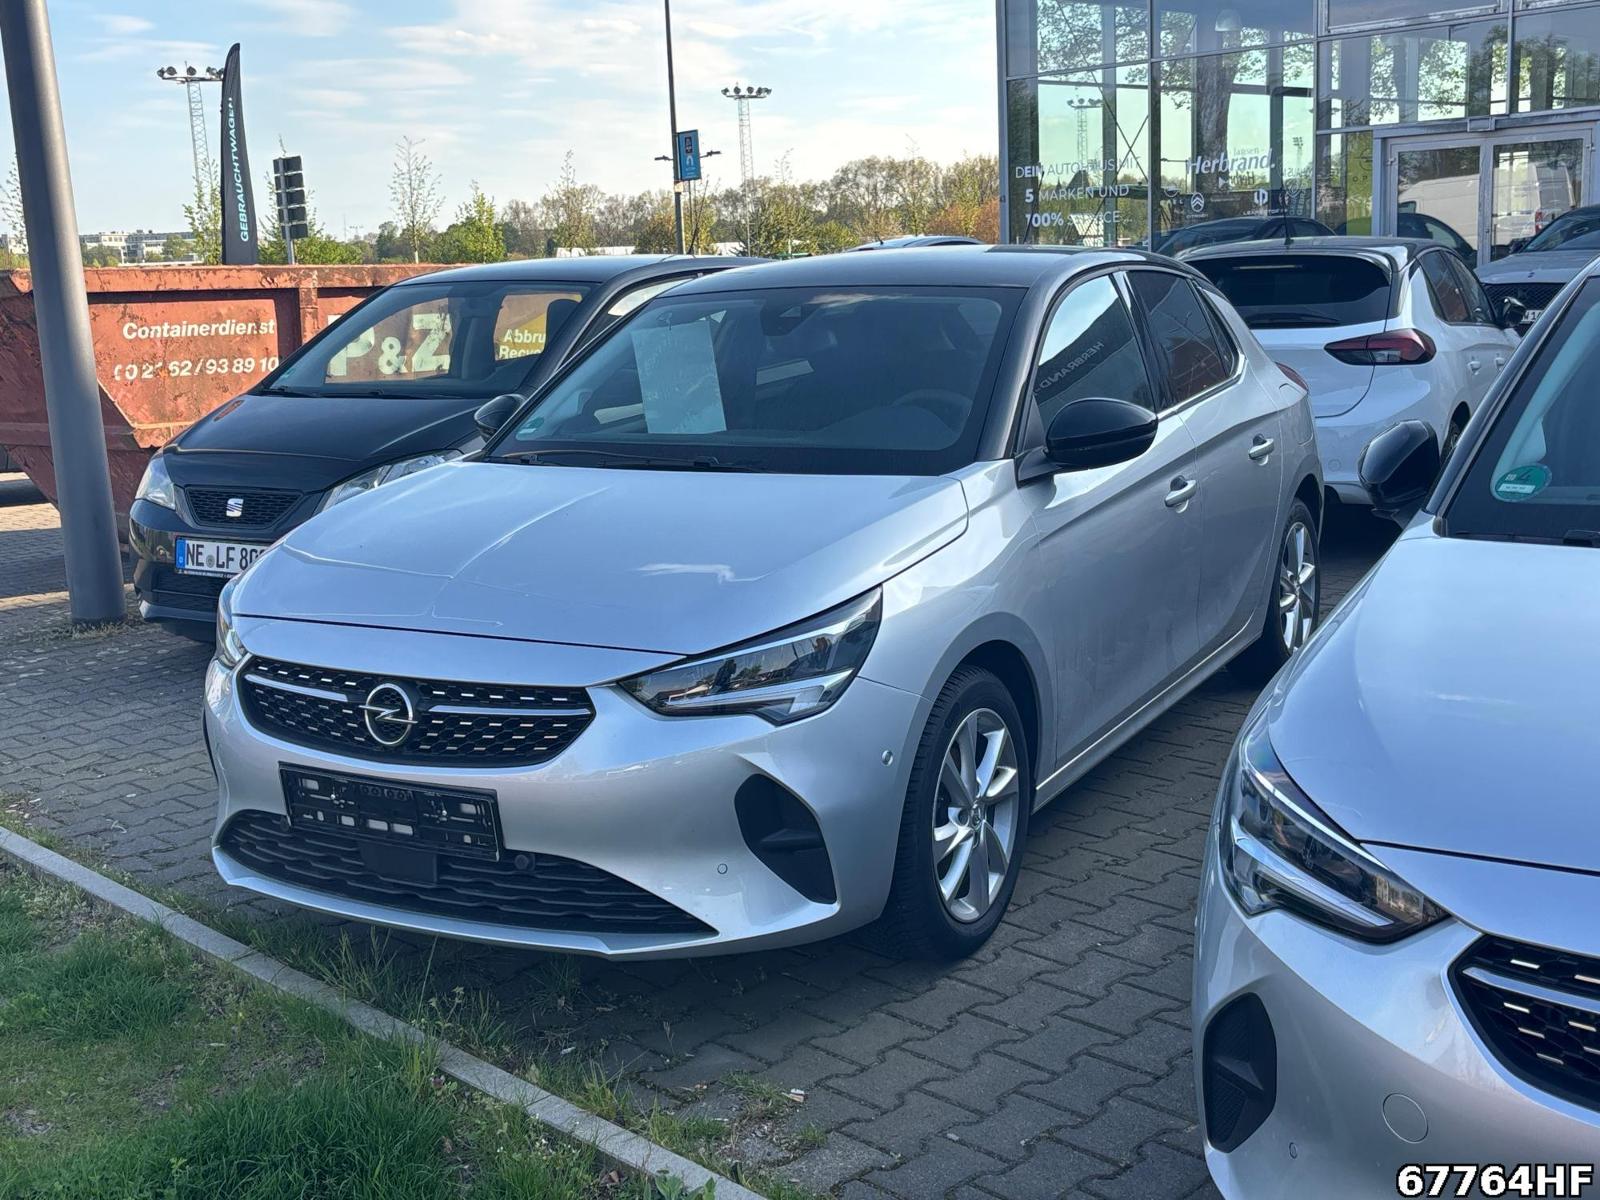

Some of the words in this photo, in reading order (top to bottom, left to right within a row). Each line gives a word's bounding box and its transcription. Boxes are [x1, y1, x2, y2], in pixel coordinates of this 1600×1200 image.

[1024, 188, 1034, 203] 5
[1039, 185, 1094, 201] MARKEN
[1098, 184, 1129, 198] UND
[1025, 212, 1063, 228] 100%
[122, 319, 275, 340] Containerdienst
[186, 543, 205, 567] NE
[215, 545, 236, 570] LF
